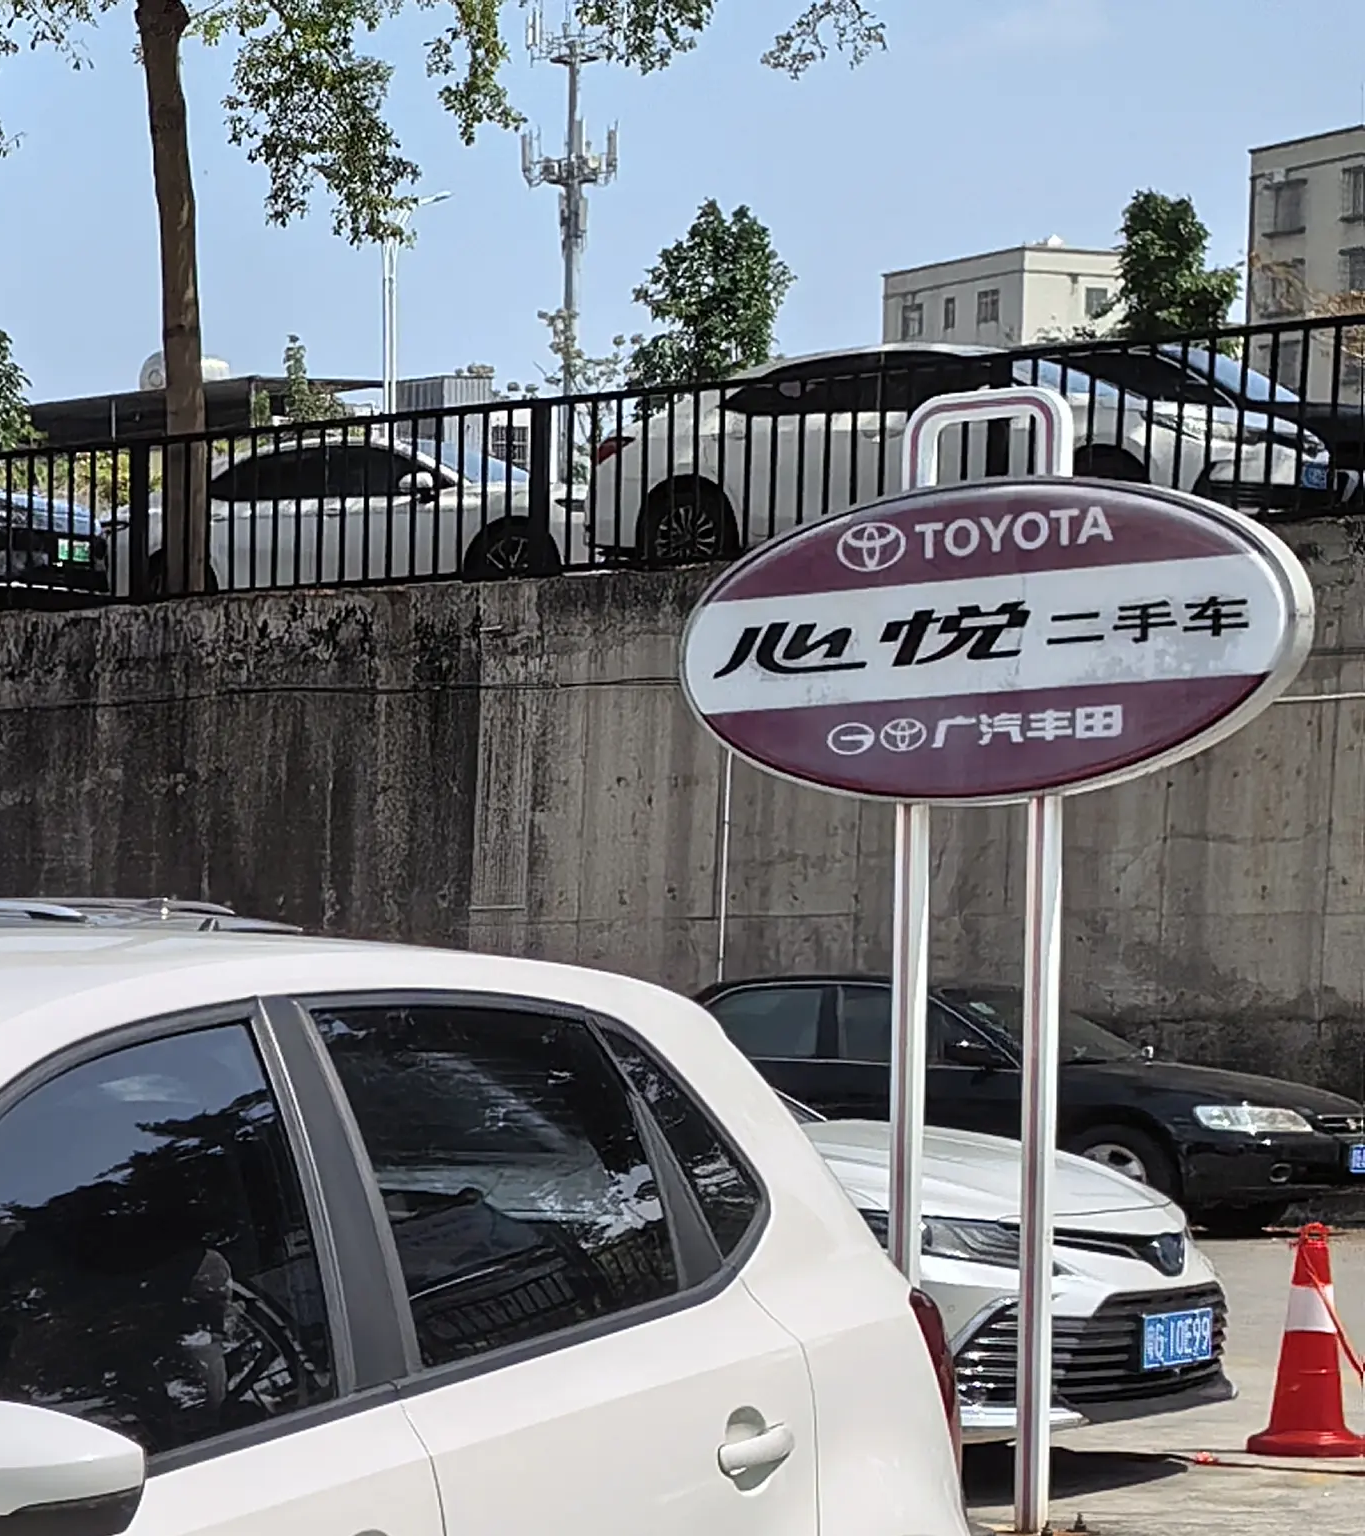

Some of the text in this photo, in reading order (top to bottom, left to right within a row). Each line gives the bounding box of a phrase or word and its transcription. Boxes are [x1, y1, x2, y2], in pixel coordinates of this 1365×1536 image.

[915, 506, 1114, 560] TOYOTA
[931, 704, 1124, 749] 广汽丰田
